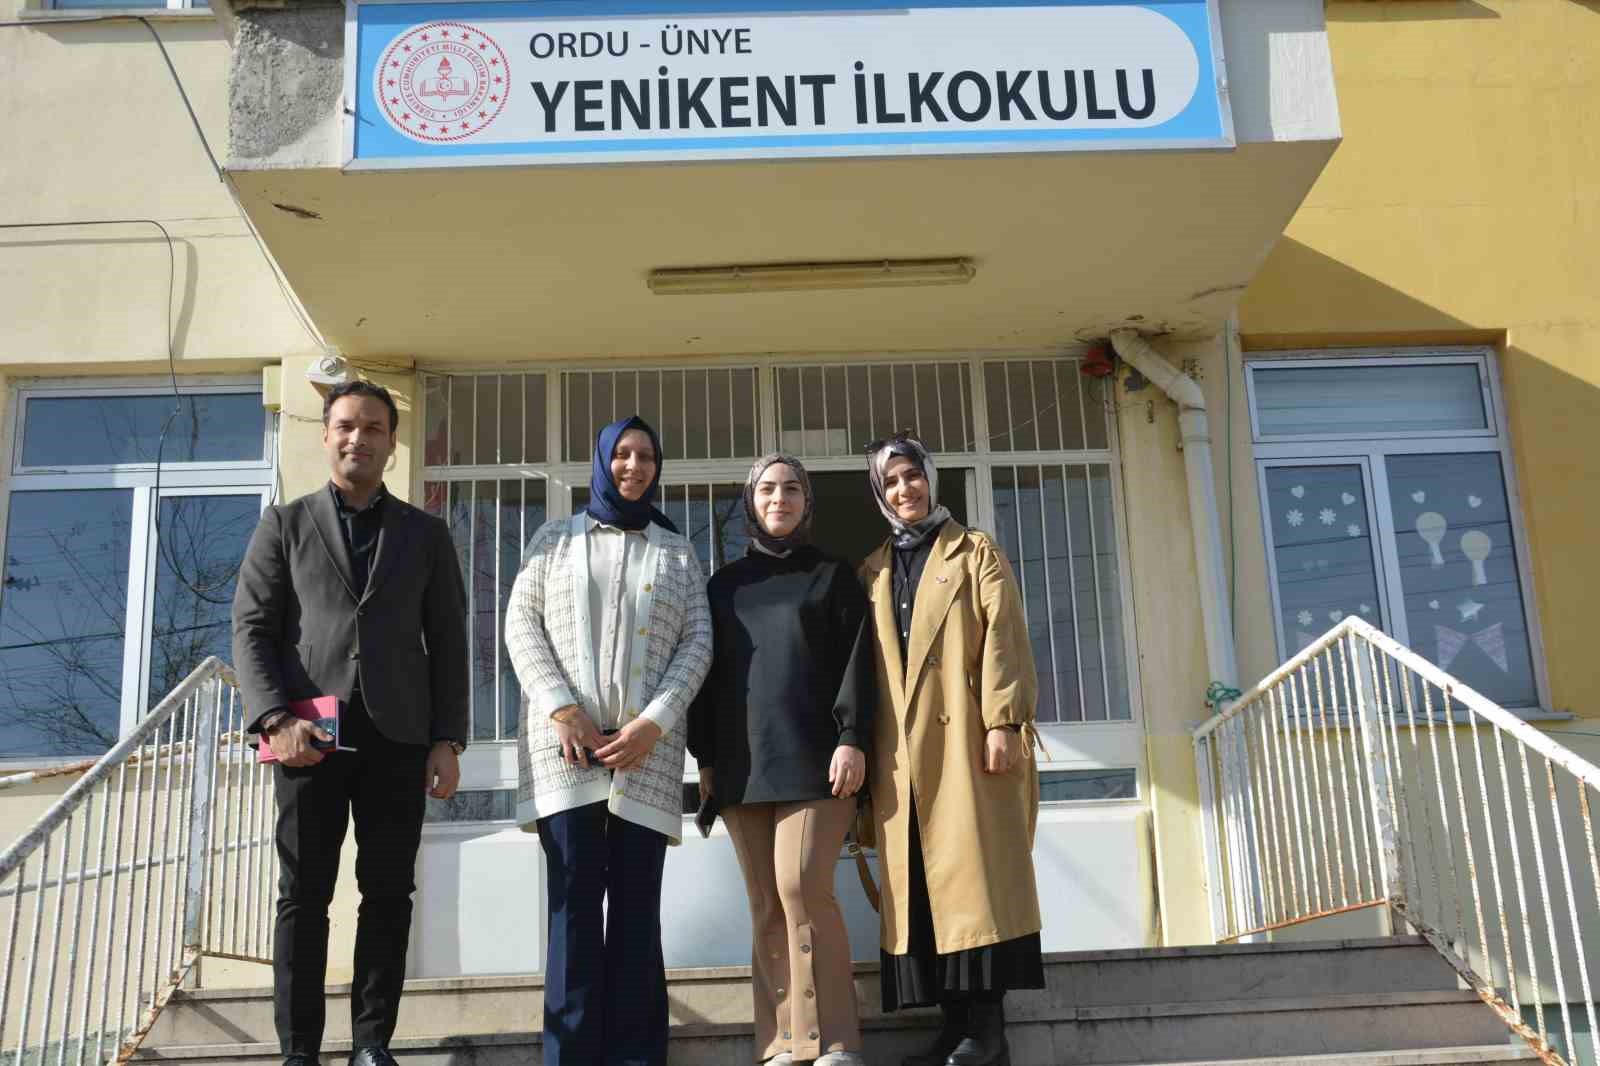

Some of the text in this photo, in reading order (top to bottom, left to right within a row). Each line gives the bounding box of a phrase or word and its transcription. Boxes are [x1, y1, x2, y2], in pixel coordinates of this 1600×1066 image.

[529, 31, 629, 59] ORDU
[660, 24, 752, 56] ÜNYE
[530, 60, 1156, 133] YENİKENT İLKOKULU
